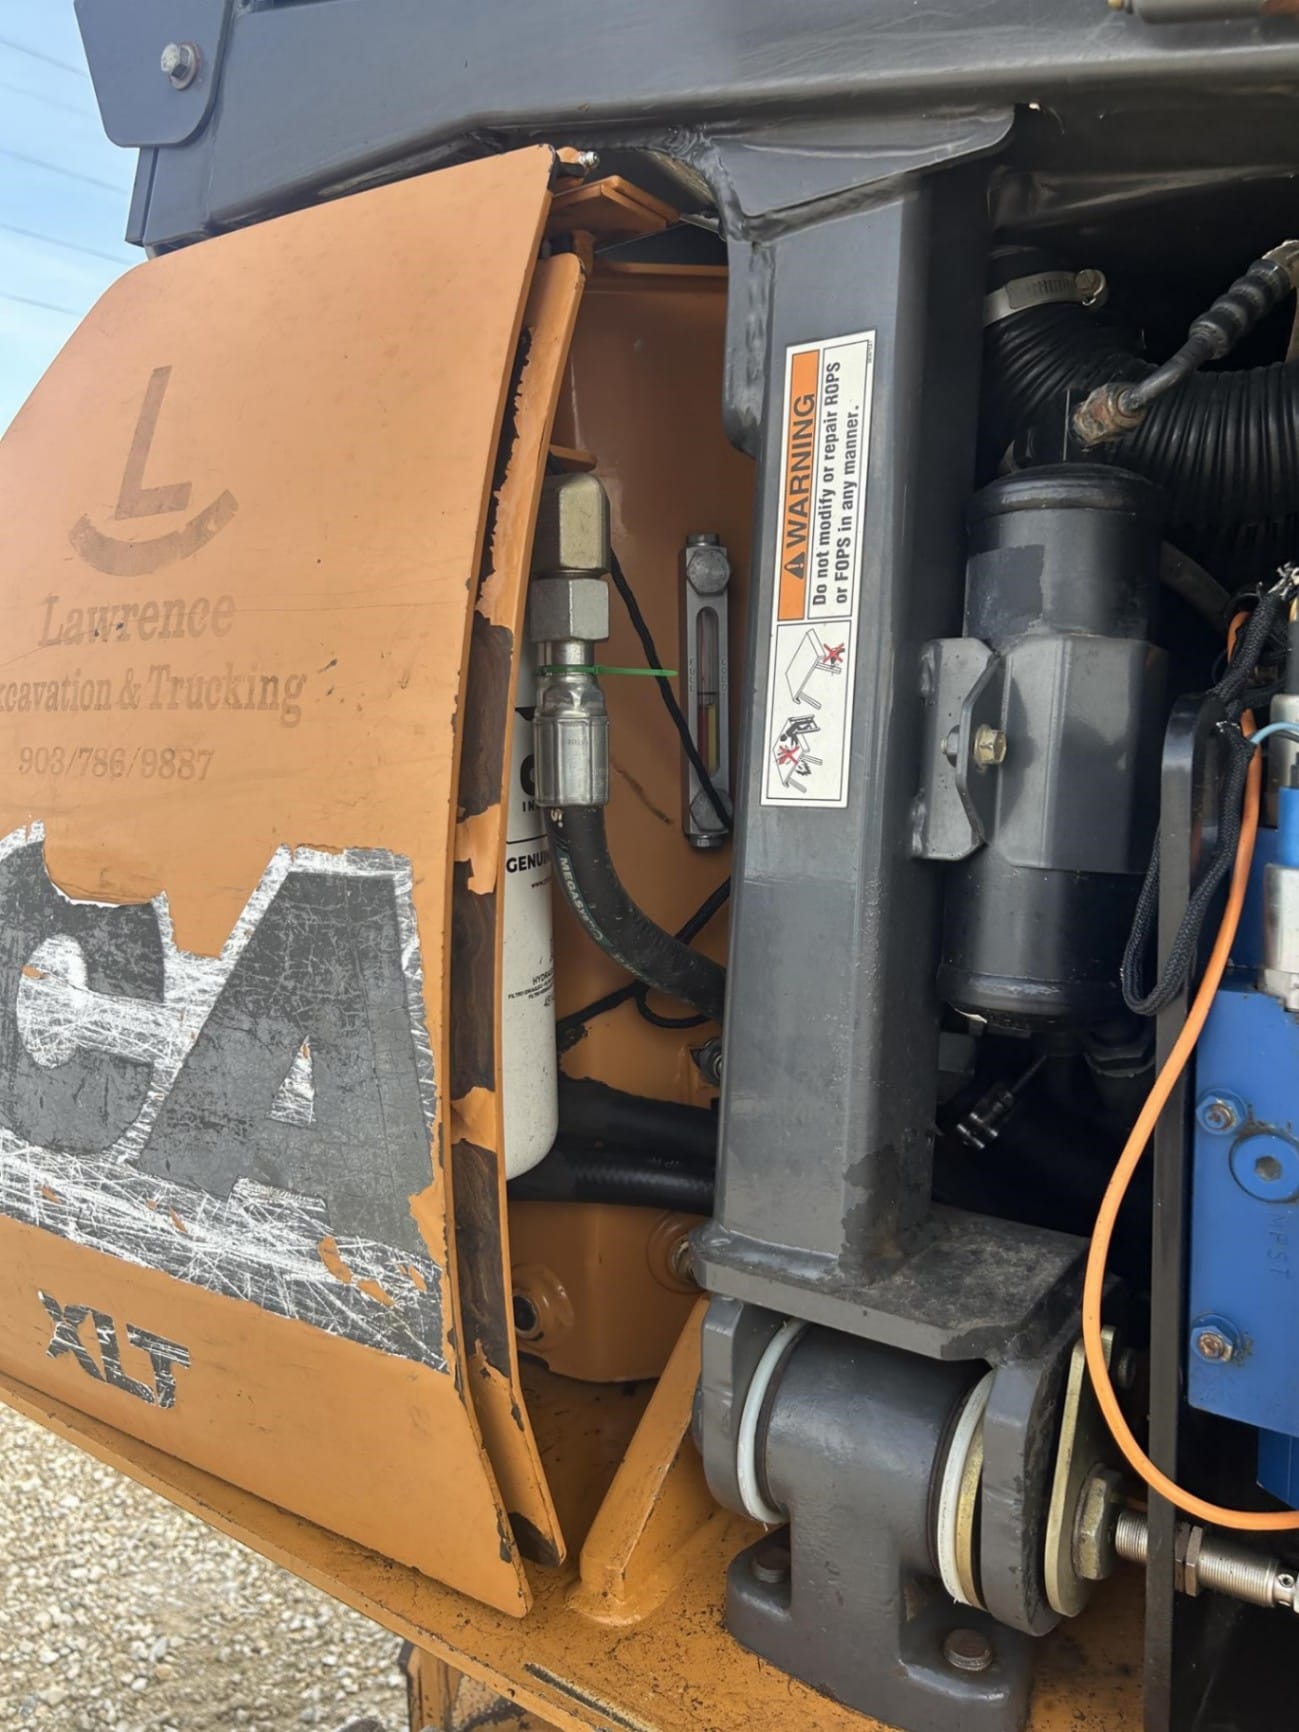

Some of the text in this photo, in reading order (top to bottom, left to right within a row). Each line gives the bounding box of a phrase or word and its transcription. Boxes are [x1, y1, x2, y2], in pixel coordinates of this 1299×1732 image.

[787, 393, 815, 550] WARNING
[813, 361, 841, 606] Do not modify or repair ROPS
[834, 405, 860, 604] or FOPS in any manner.
[38, 594, 236, 647] Lawrence
[119, 667, 141, 710] &
[149, 662, 307, 728] Trucking
[18, 746, 215, 781] 903/786/9887
[37, 1288, 191, 1408] XLT
